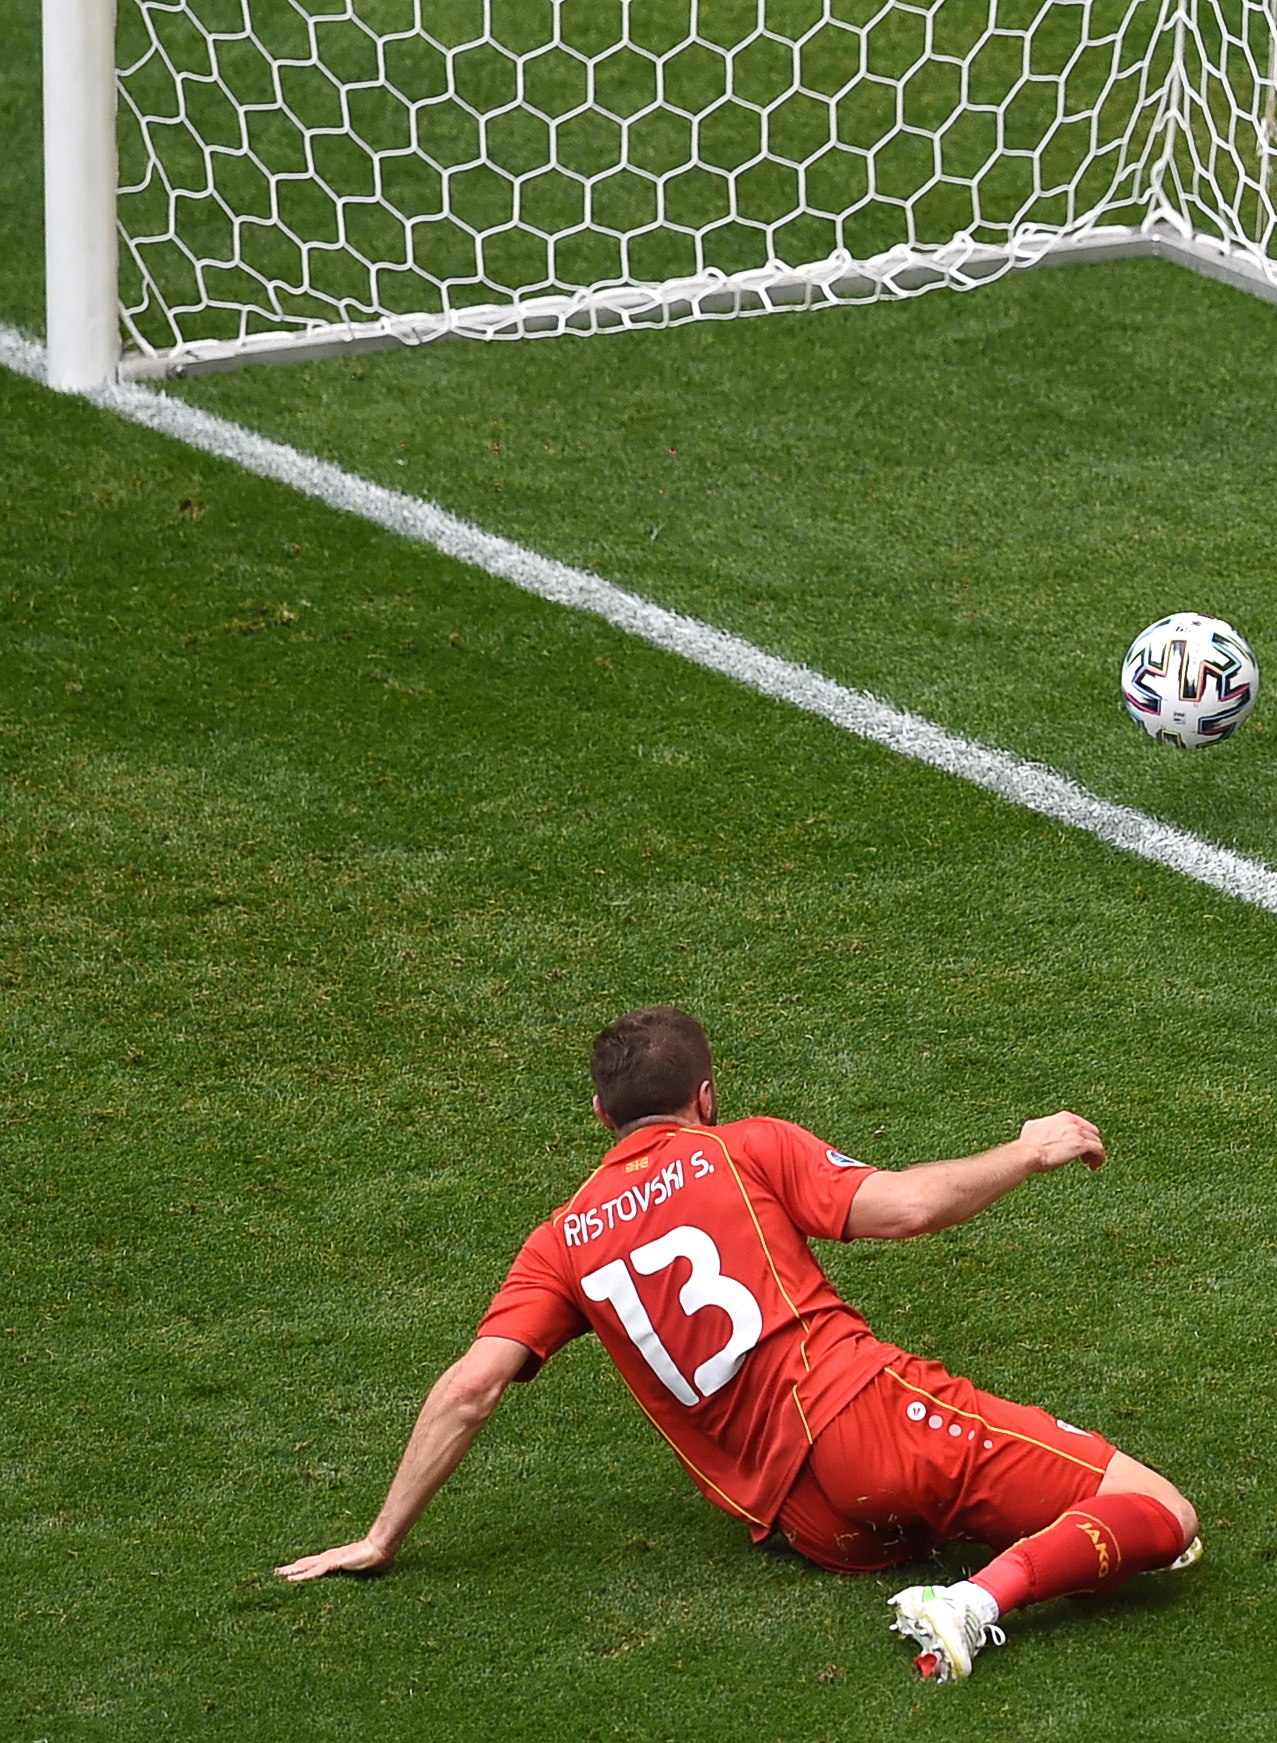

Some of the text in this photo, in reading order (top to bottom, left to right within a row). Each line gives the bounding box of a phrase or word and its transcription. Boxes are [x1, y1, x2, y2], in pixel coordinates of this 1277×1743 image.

[563, 1150, 715, 1247] RISTOVSKI S.
[580, 1225, 763, 1406] 13
[1075, 1522, 1109, 1578] JAKO
